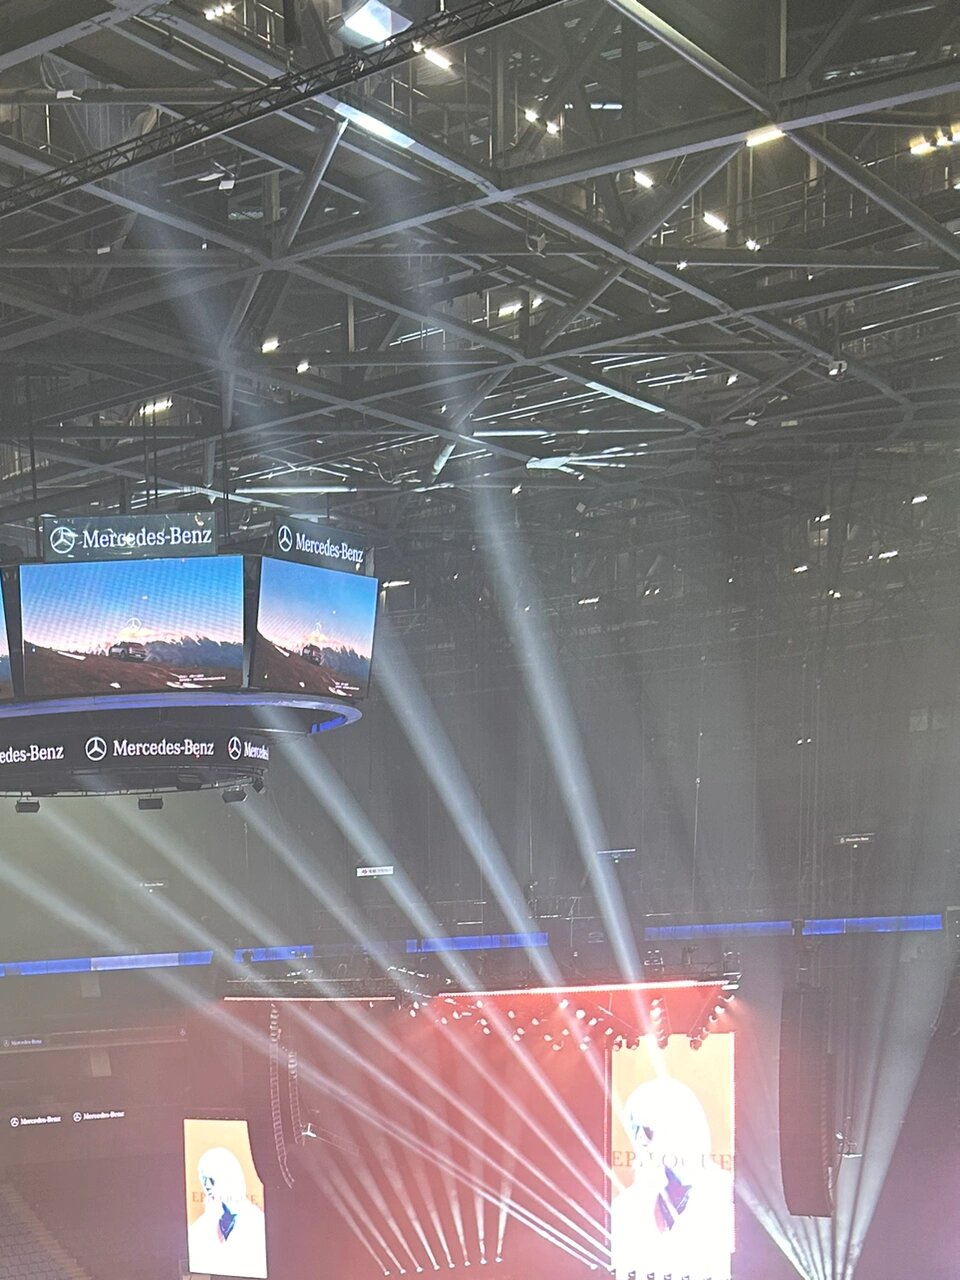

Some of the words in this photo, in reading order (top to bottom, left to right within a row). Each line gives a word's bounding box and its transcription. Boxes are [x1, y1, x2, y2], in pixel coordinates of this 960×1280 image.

[82, 526, 212, 549] Mercedes-Benz
[295, 533, 364, 563] Mercedes-Benz
[113, 738, 215, 757] Mercedes-Benz
